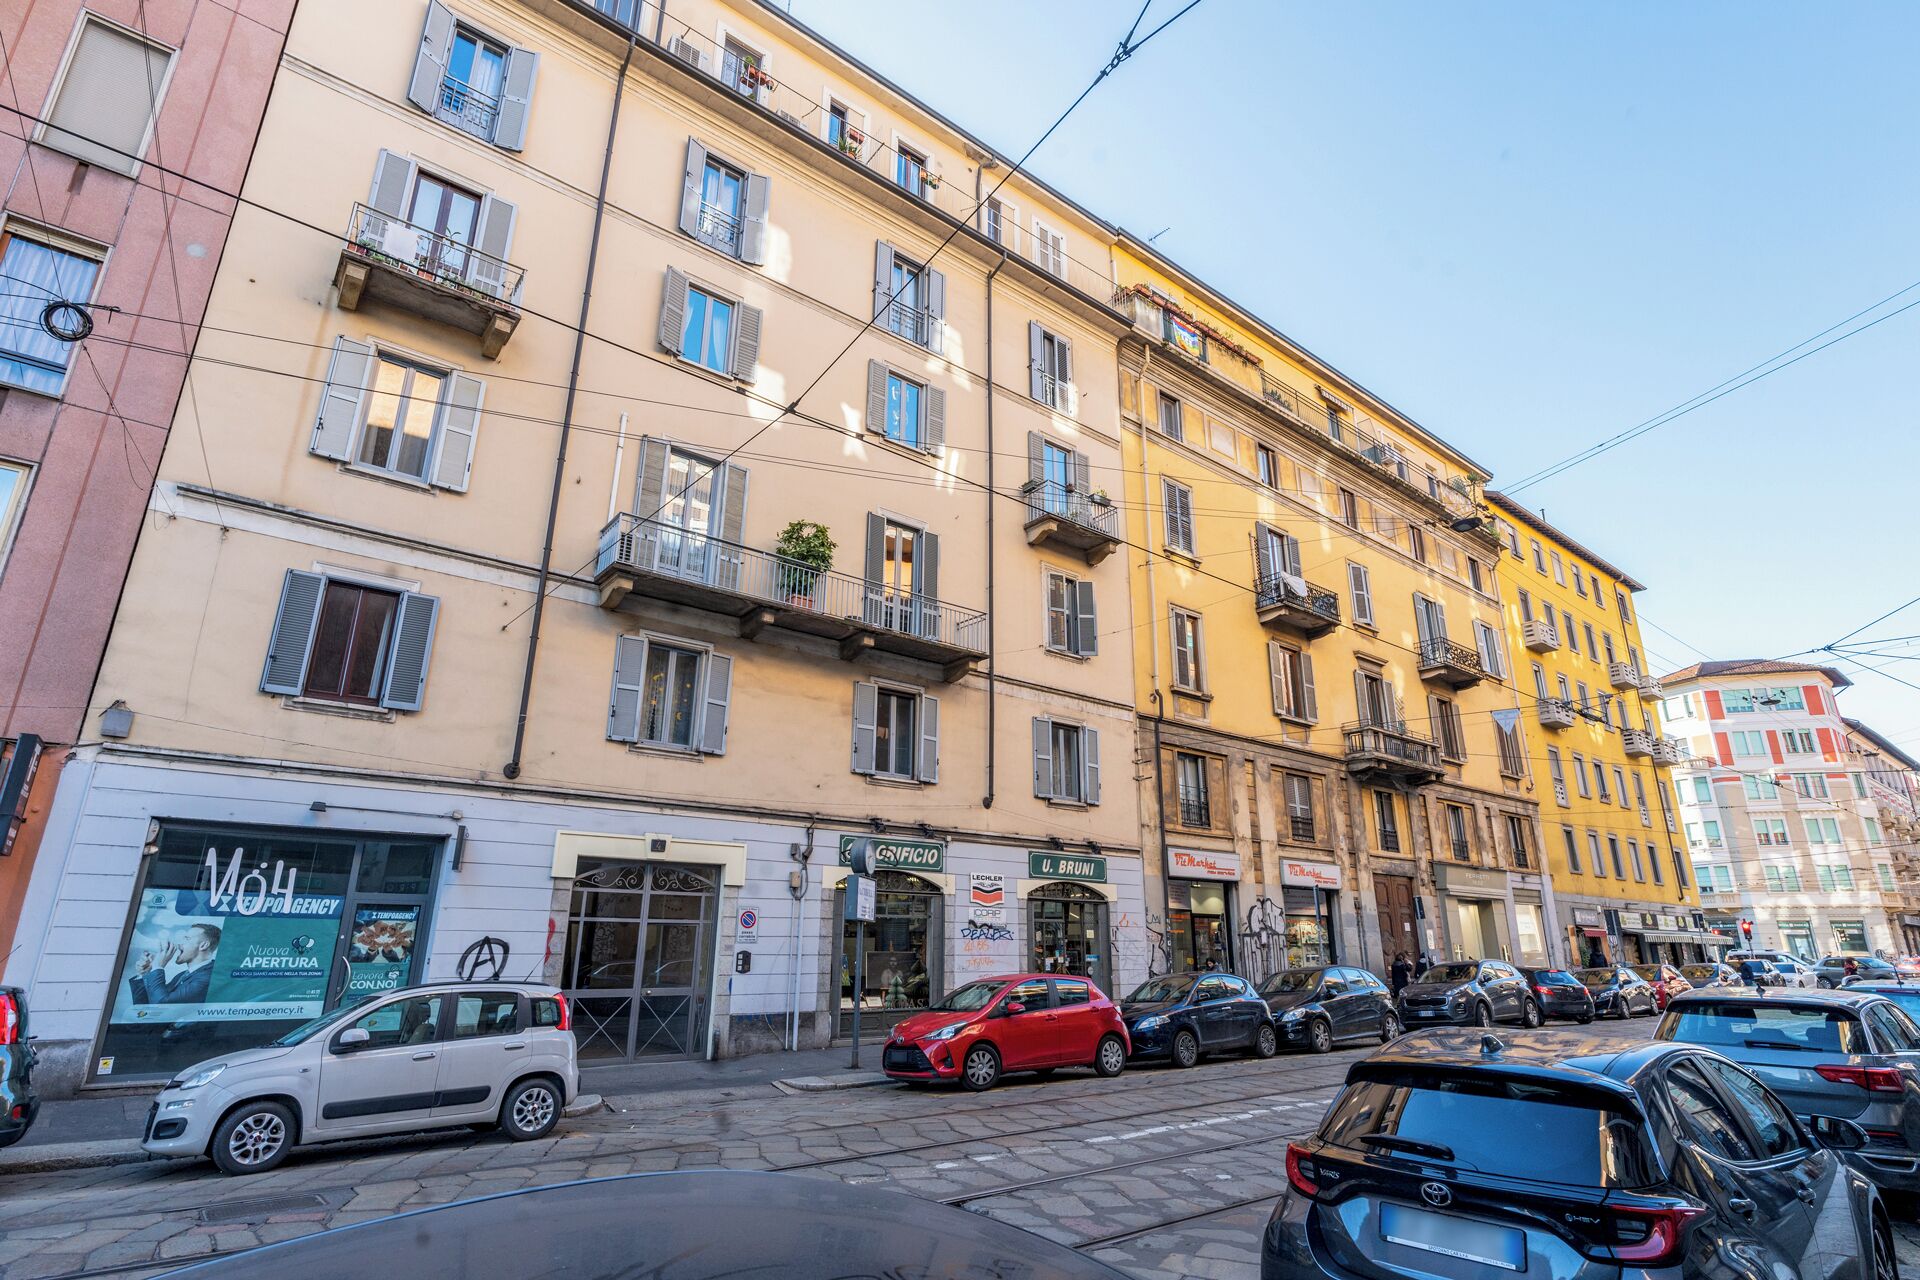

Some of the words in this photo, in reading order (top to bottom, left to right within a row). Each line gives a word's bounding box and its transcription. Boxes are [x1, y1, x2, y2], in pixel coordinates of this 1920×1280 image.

[1042, 859, 1053, 873] U.
[1058, 861, 1095, 876] BRUNI
[972, 874, 1003, 882] LECHLER
[377, 912, 417, 920] TEMPOAGENCY
[247, 945, 290, 956] Nuova
[240, 957, 319, 968] APERTURA
[352, 970, 384, 980] Lavora
[376, 980, 398, 989] NOI
[197, 1005, 304, 1016] www.tempoagency.it
[1320, 1168, 1340, 1179] YARIS
